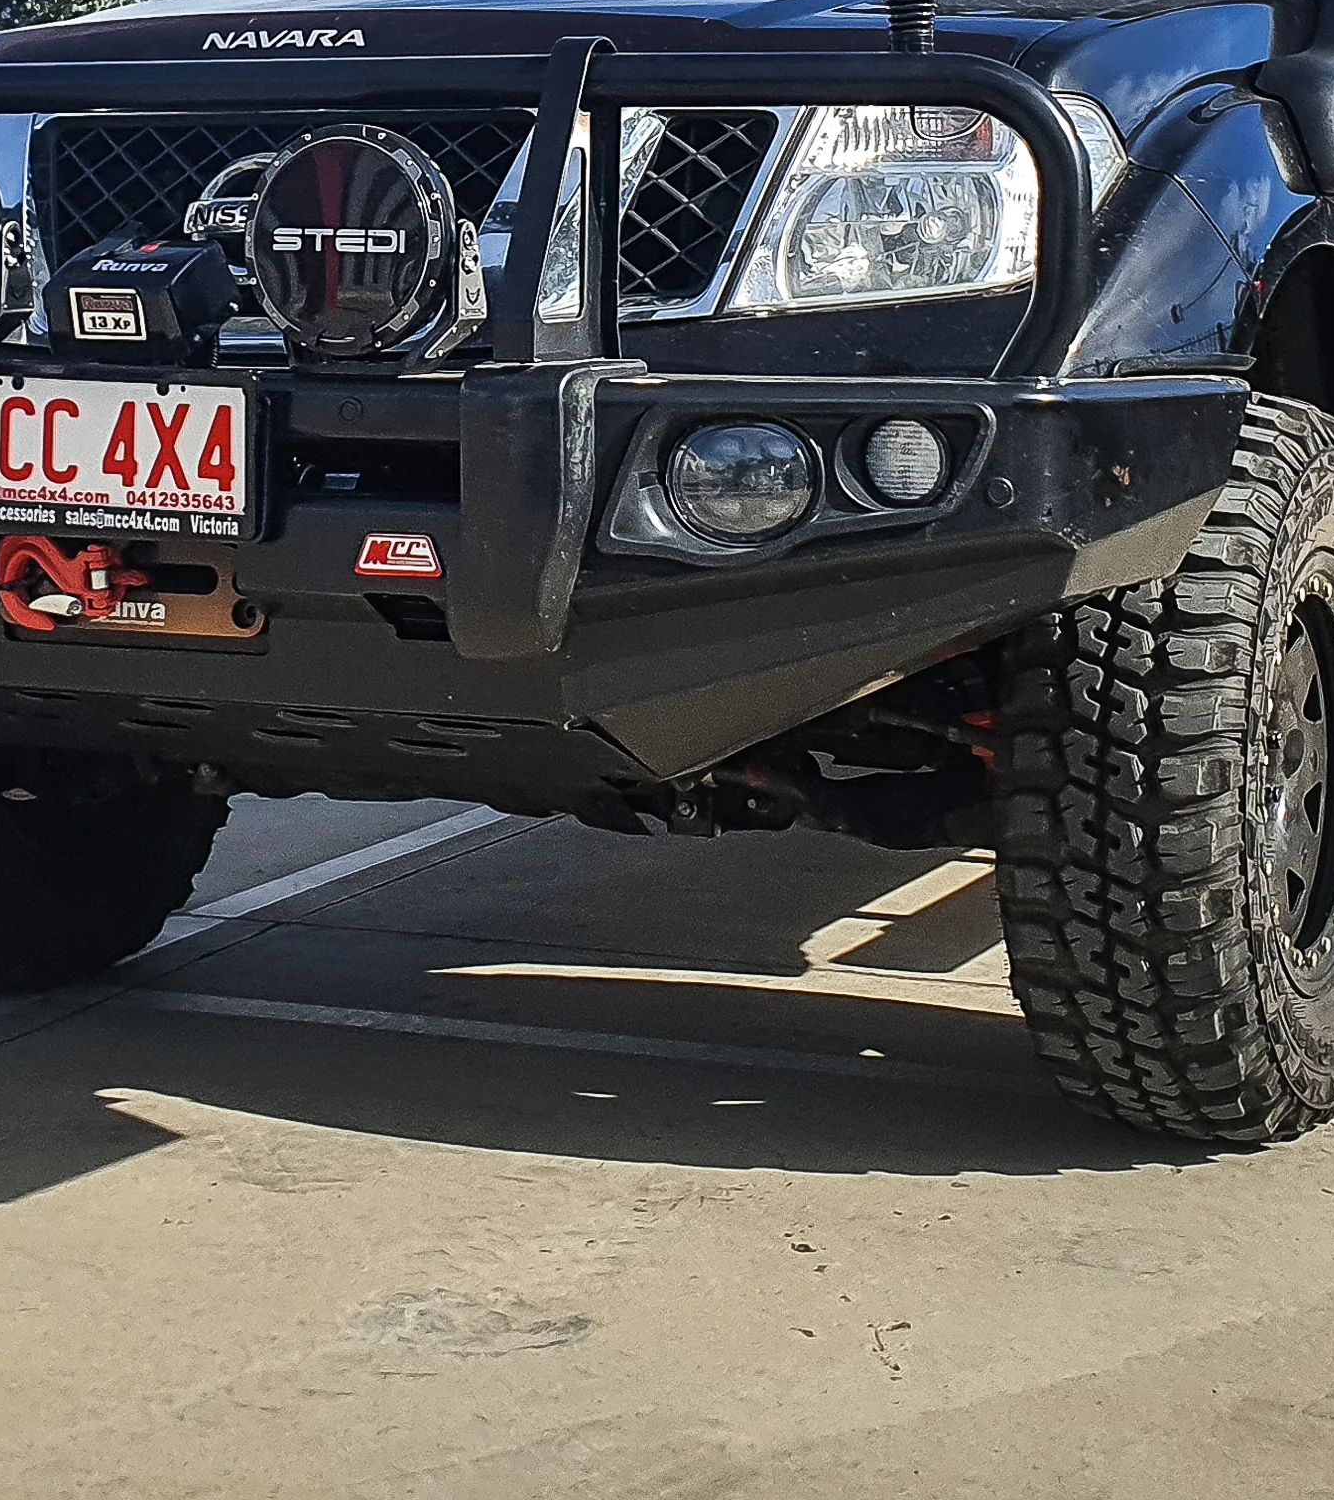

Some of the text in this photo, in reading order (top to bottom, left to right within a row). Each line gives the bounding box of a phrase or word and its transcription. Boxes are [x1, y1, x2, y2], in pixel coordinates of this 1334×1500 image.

[202, 29, 366, 50] NAVARA
[272, 229, 406, 254] STEDI
[92, 259, 169, 272] Runva
[89, 315, 109, 329] 13
[102, 401, 236, 492] 4X4
[125, 490, 236, 511] 0412935643
[65, 508, 180, 533] sales@mcc4x4.com
[190, 514, 239, 536] Victoria
[363, 540, 430, 564] MCC
